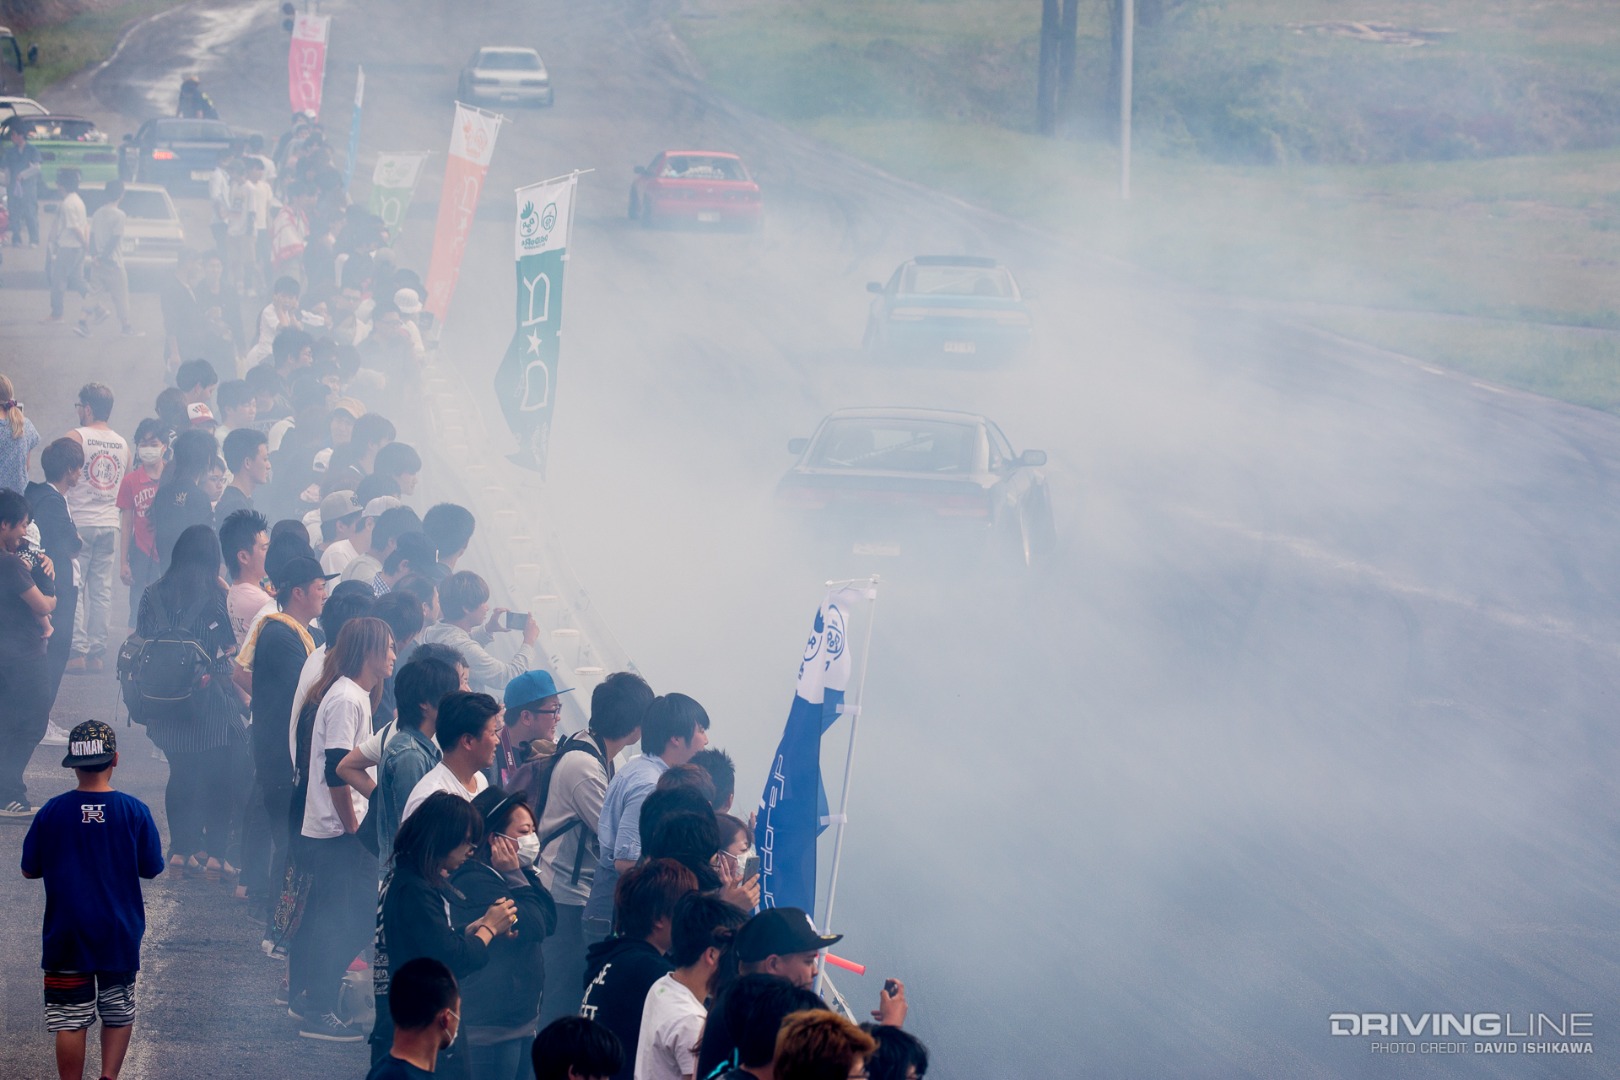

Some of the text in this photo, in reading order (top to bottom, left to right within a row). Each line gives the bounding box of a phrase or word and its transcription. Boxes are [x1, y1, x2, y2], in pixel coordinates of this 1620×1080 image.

[72, 740, 103, 756] BATMAN
[80, 803, 106, 811] GT
[81, 810, 106, 824] R
